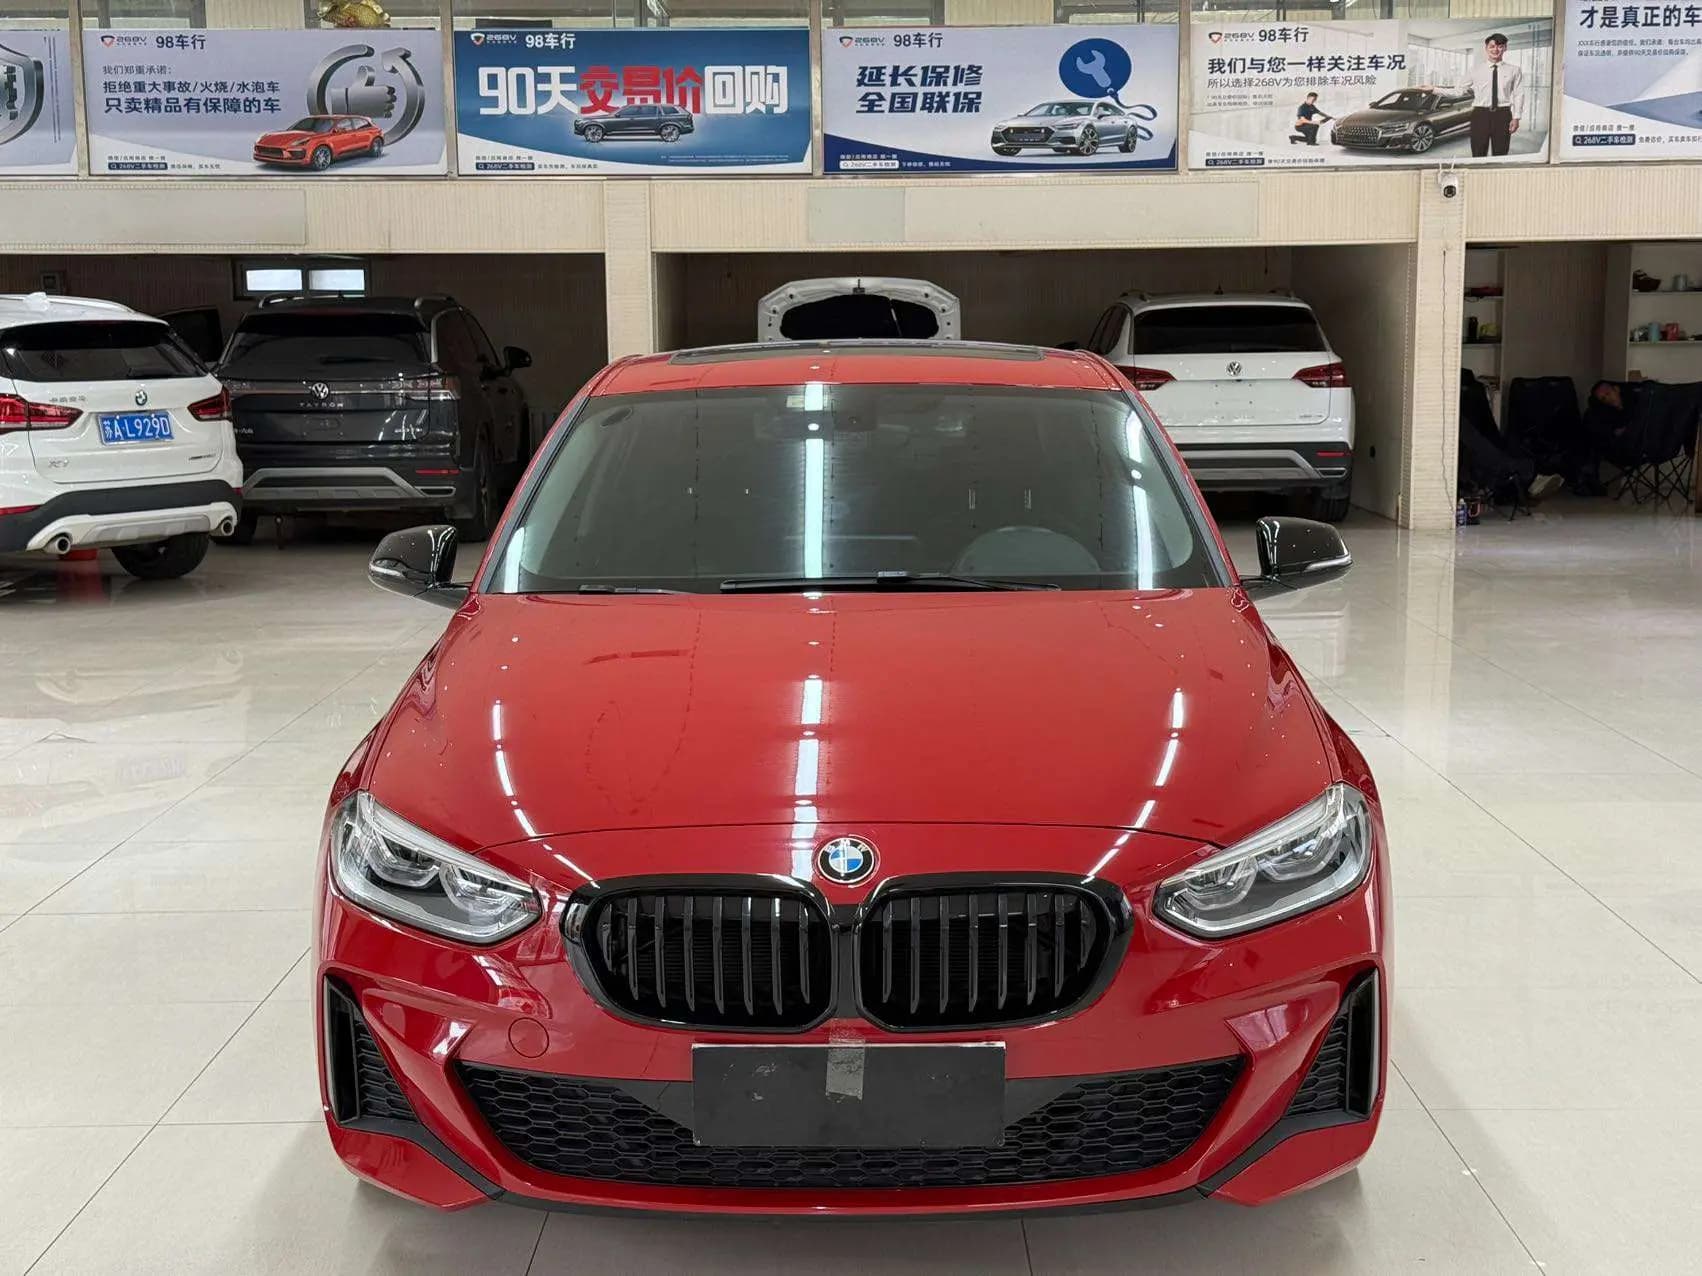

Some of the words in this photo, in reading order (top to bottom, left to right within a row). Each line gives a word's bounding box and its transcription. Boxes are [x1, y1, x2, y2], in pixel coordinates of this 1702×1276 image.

[155, 34, 206, 50] 98车行
[525, 33, 576, 49] 98车行
[893, 32, 943, 48] 98车行
[1258, 27, 1309, 43] 98车行
[1207, 54, 1406, 74] 我们与您一样关注车况
[856, 64, 983, 87] 延长保修
[1207, 74, 1377, 89] 所以选择268V为您排除车况风险
[103, 80, 281, 94] 拒绝重大事故/火烧/水泡车
[478, 65, 789, 115] 90天交易价回购
[104, 97, 282, 114] 只卖精品有保障的车
[856, 91, 982, 114] 全国联保
